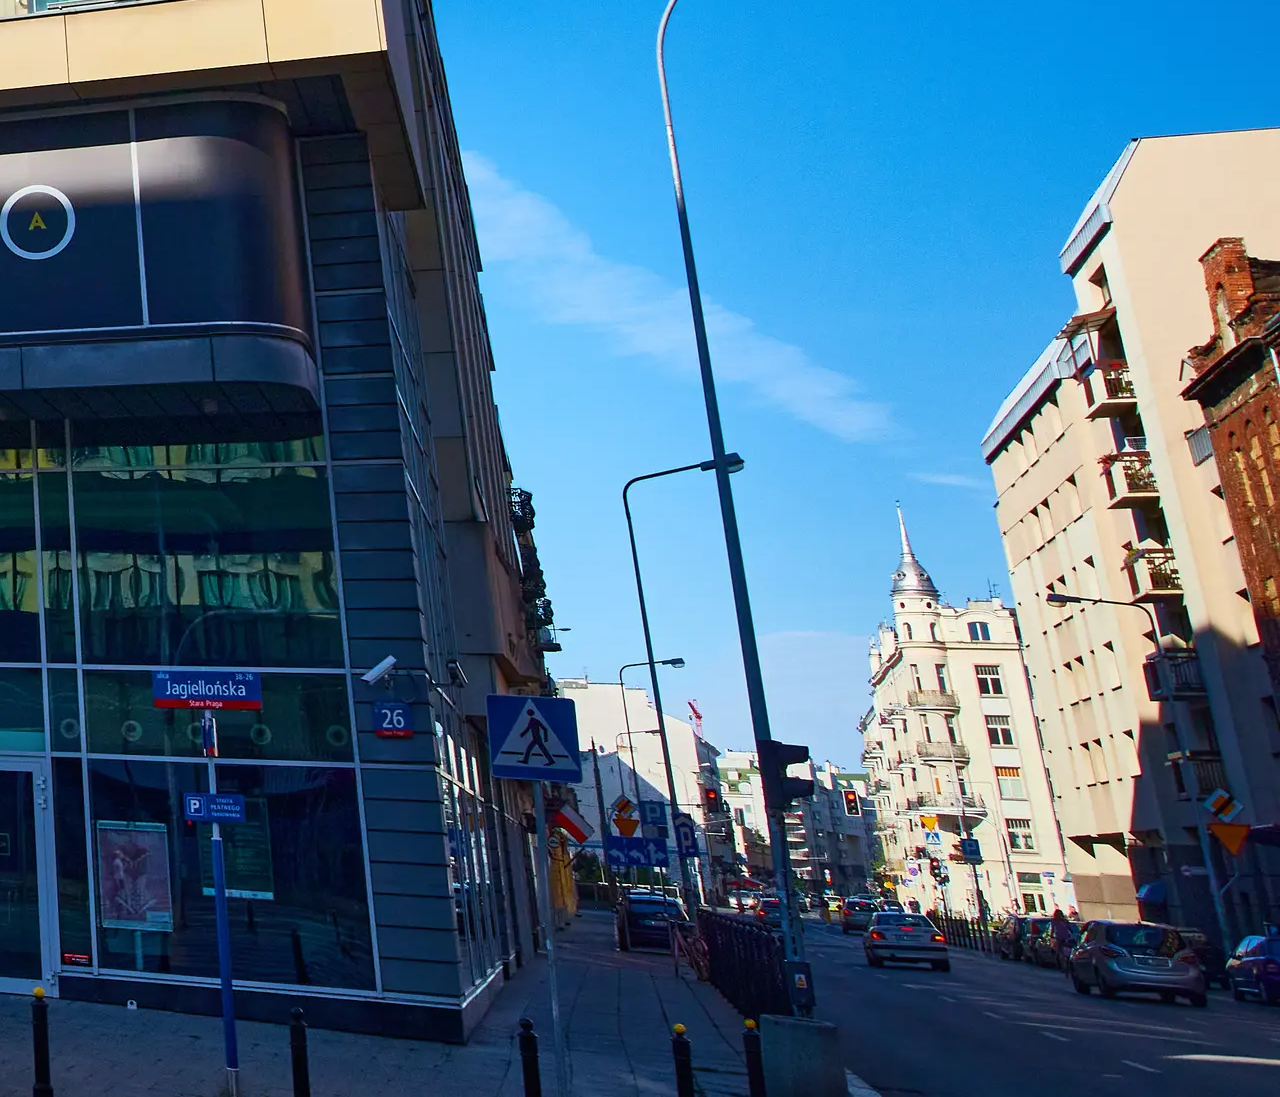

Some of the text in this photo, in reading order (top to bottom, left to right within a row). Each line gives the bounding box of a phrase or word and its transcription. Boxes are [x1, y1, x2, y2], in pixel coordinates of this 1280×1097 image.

[166, 680, 246, 699] Jagiellońska
[206, 700, 223, 709] Praga
[381, 709, 405, 729] 26
[190, 798, 200, 813] P
